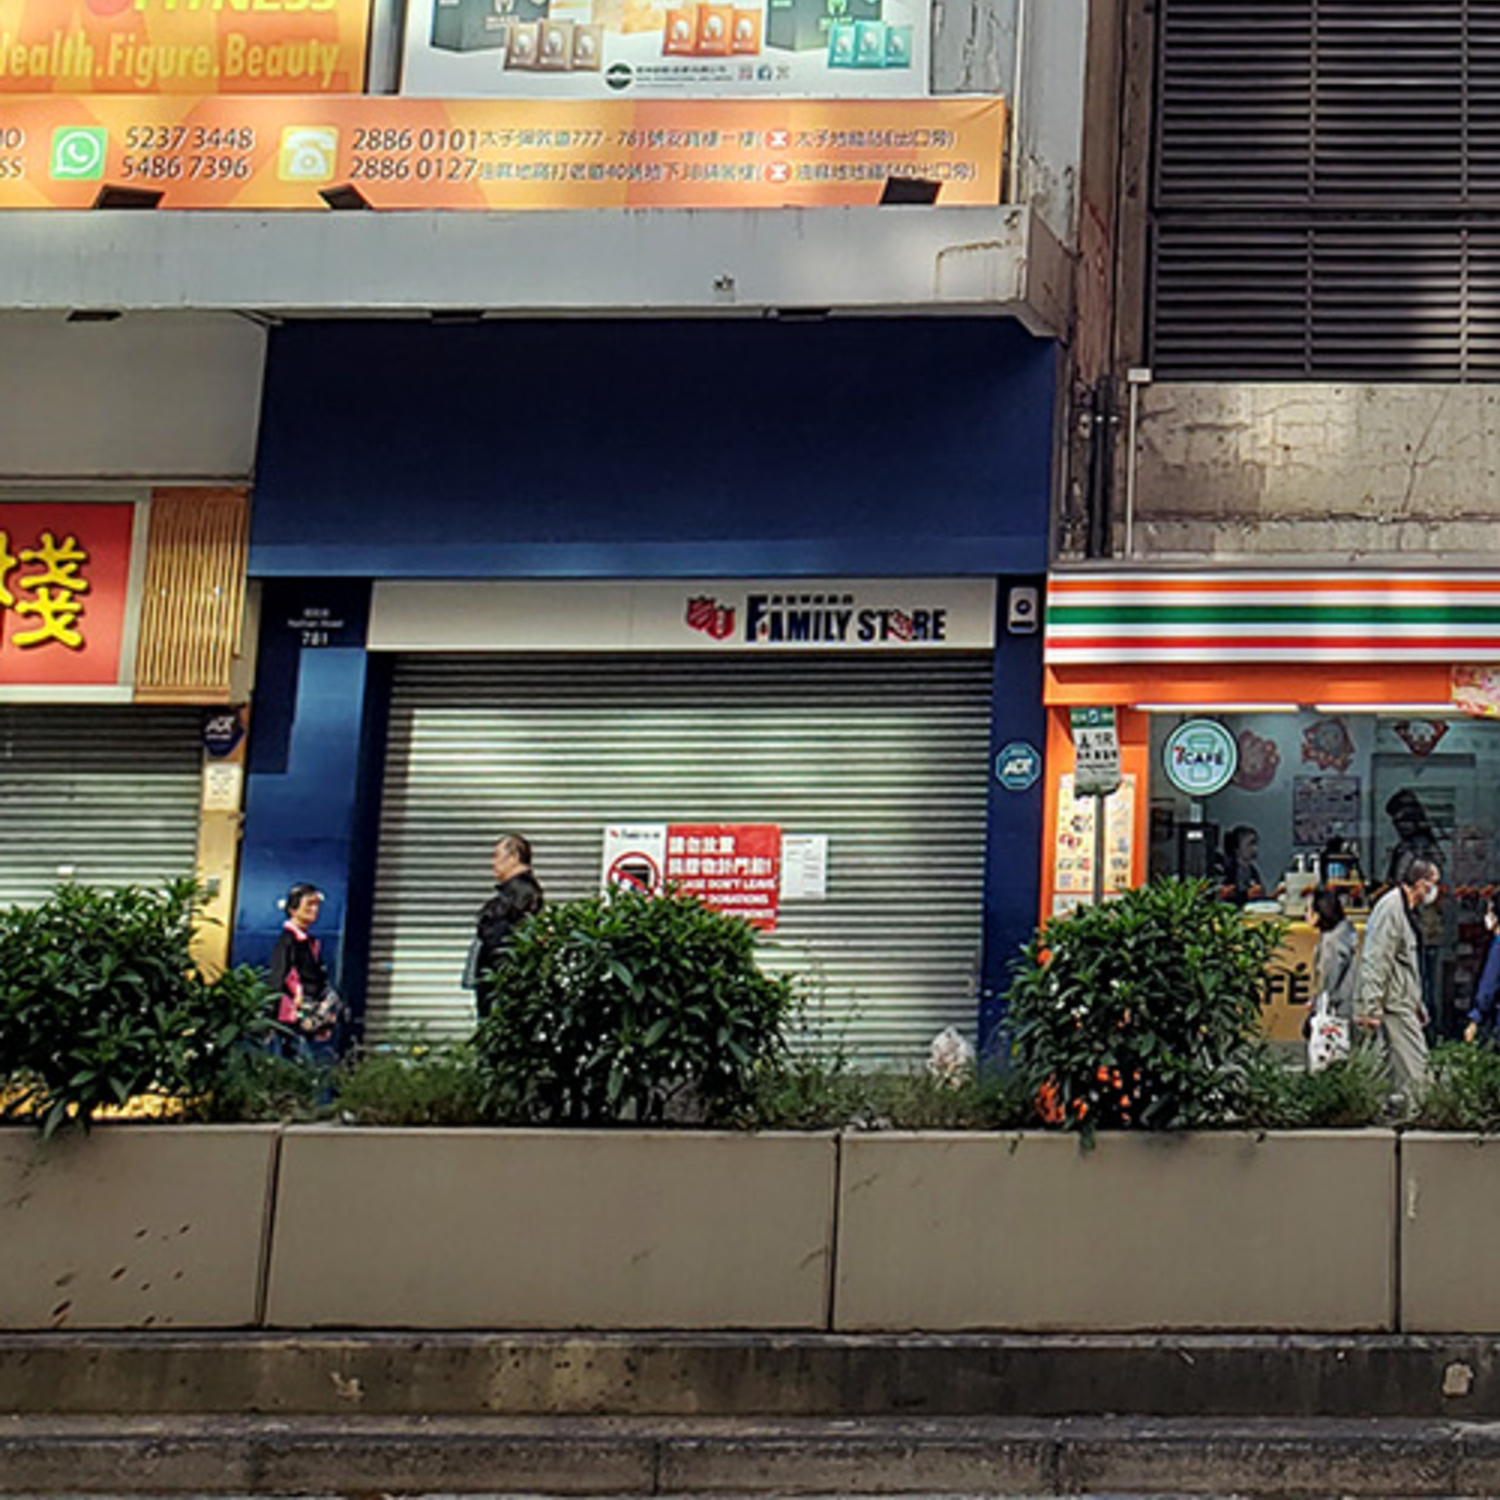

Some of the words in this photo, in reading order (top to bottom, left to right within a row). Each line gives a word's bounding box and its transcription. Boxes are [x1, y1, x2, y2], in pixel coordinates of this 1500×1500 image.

[126, 126, 186, 150] 5237
[193, 127, 254, 150] 3448
[353, 129, 413, 152] 2886
[418, 129, 478, 152] 0101
[121, 156, 181, 179] 5486
[189, 156, 250, 179] 7396
[350, 157, 411, 180] 2886
[416, 157, 477, 180] 0127
[745, 595, 854, 642] FAMILY
